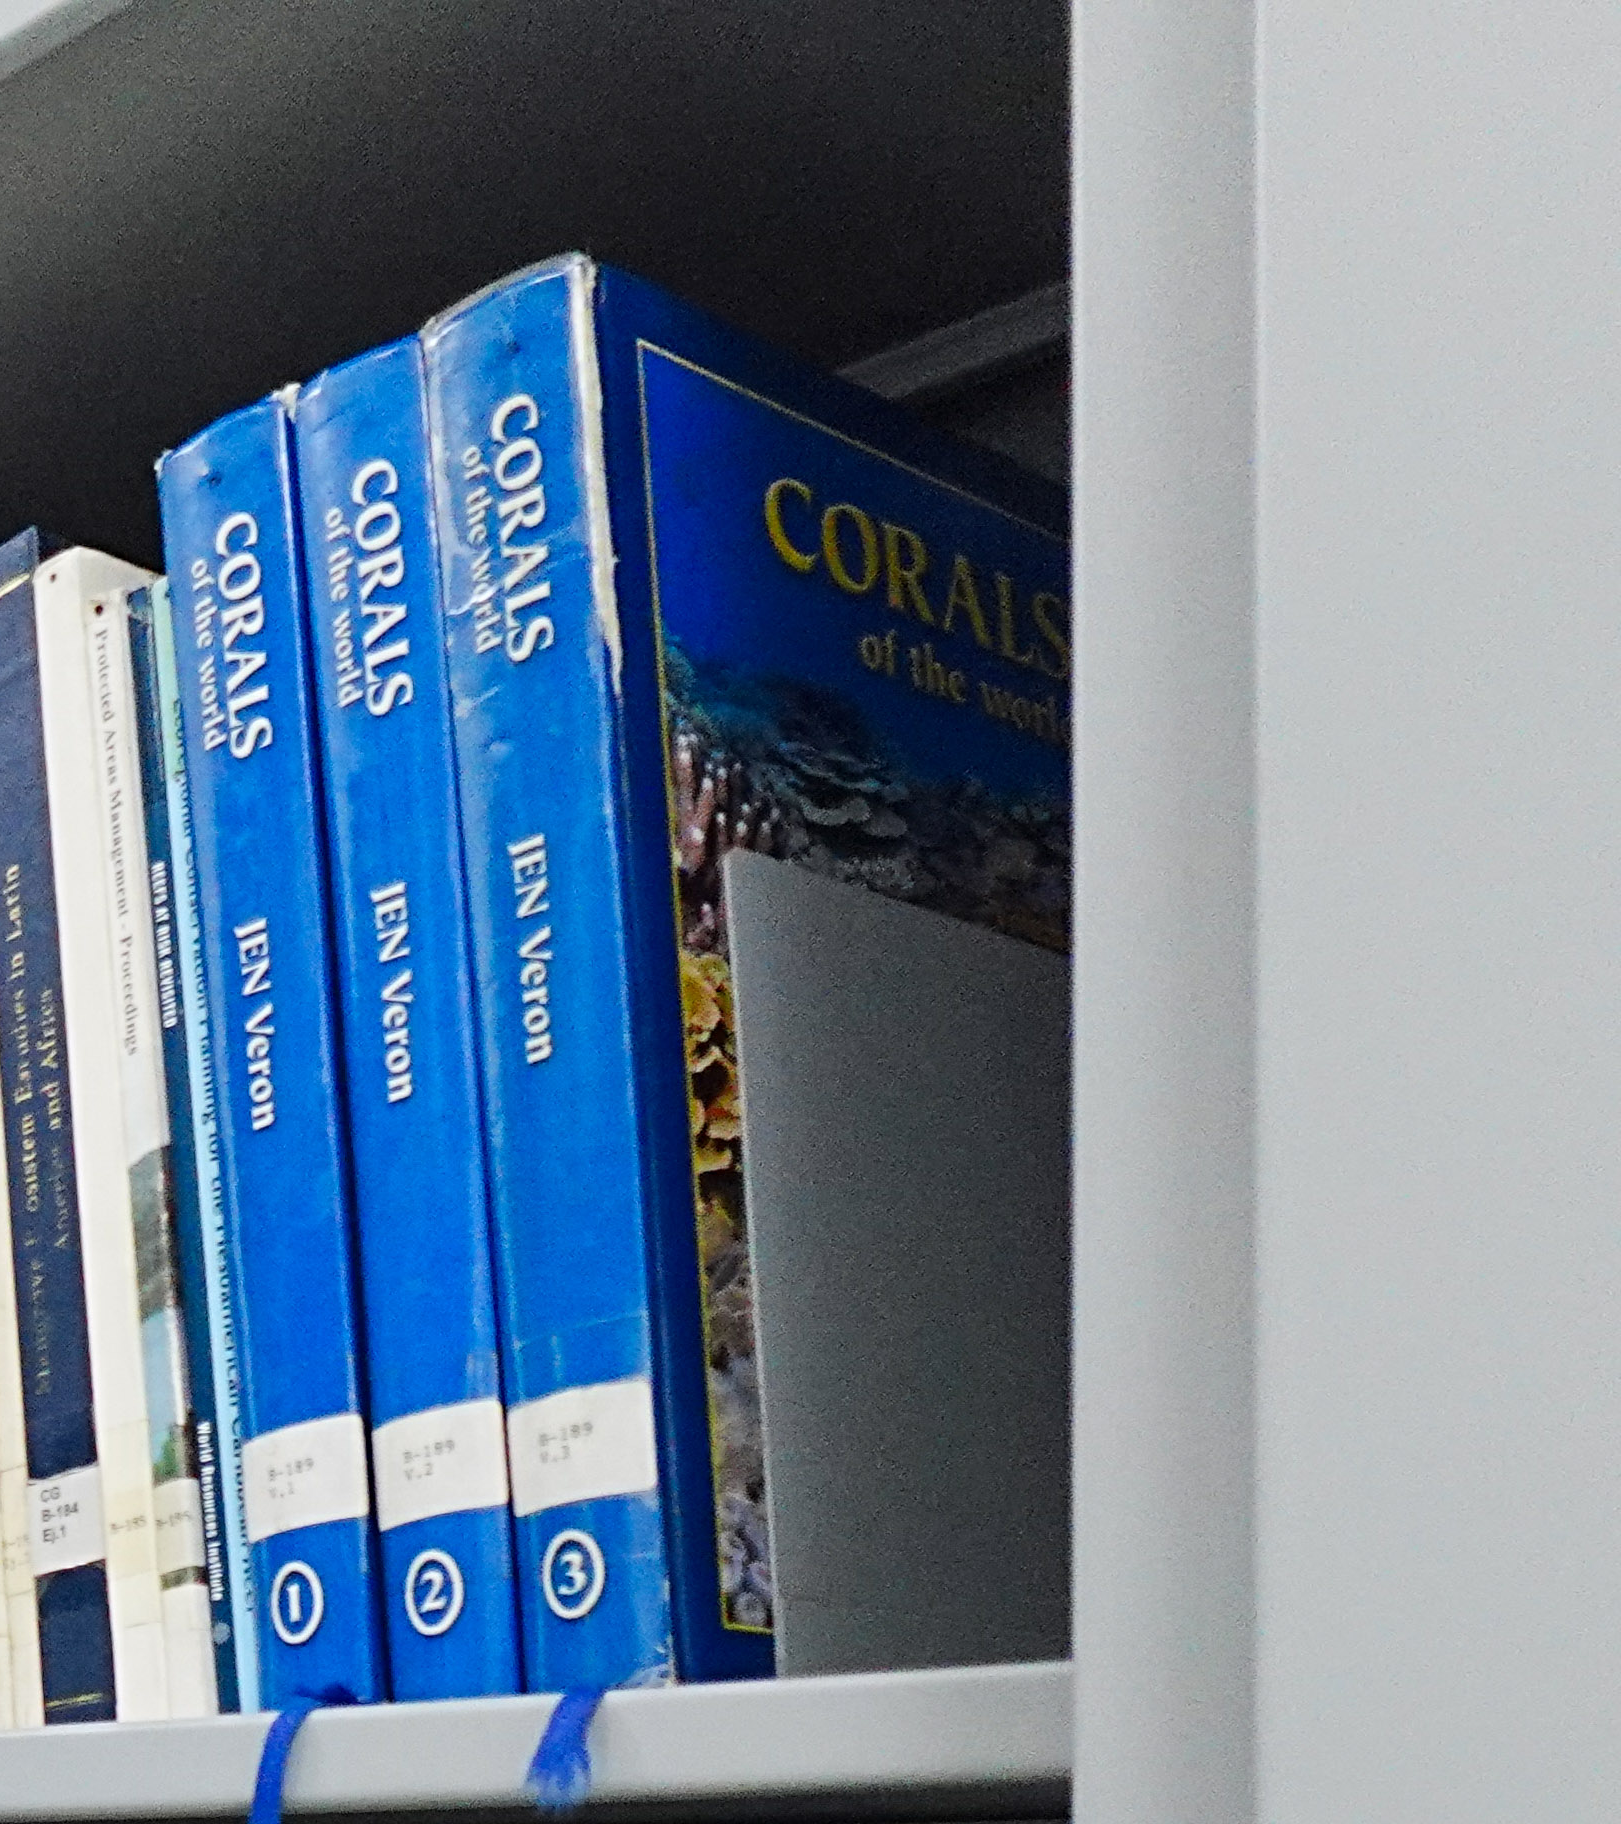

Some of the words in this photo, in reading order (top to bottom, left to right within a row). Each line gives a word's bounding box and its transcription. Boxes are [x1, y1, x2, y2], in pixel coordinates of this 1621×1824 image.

[459, 448, 487, 479] of
[323, 507, 352, 538] of
[463, 486, 494, 543] the
[489, 392, 556, 663] CORALS
[190, 560, 217, 590] of
[326, 546, 357, 601] the
[350, 457, 416, 716] CORALS
[468, 552, 504, 653] world
[763, 477, 1069, 678] CORALS
[192, 596, 222, 648] the
[213, 511, 275, 759] CORALS
[331, 609, 365, 707] world
[95, 630, 116, 724] Protected
[196, 654, 230, 750] world
[105, 731, 121, 787] Areas
[111, 790, 130, 918] Management
[507, 831, 551, 918] JEN
[234, 917, 271, 996] JEN
[367, 881, 409, 964] JEN
[115, 934, 143, 1056] Proceedings
[378, 970, 416, 1103] Veron
[517, 924, 557, 1065] Veron
[243, 1001, 279, 1131] Veron
[40, 1486, 61, 1503] CG
[41, 1502, 79, 1522] B-184
[417, 1568, 448, 1614] 2
[558, 1551, 586, 1596] 3
